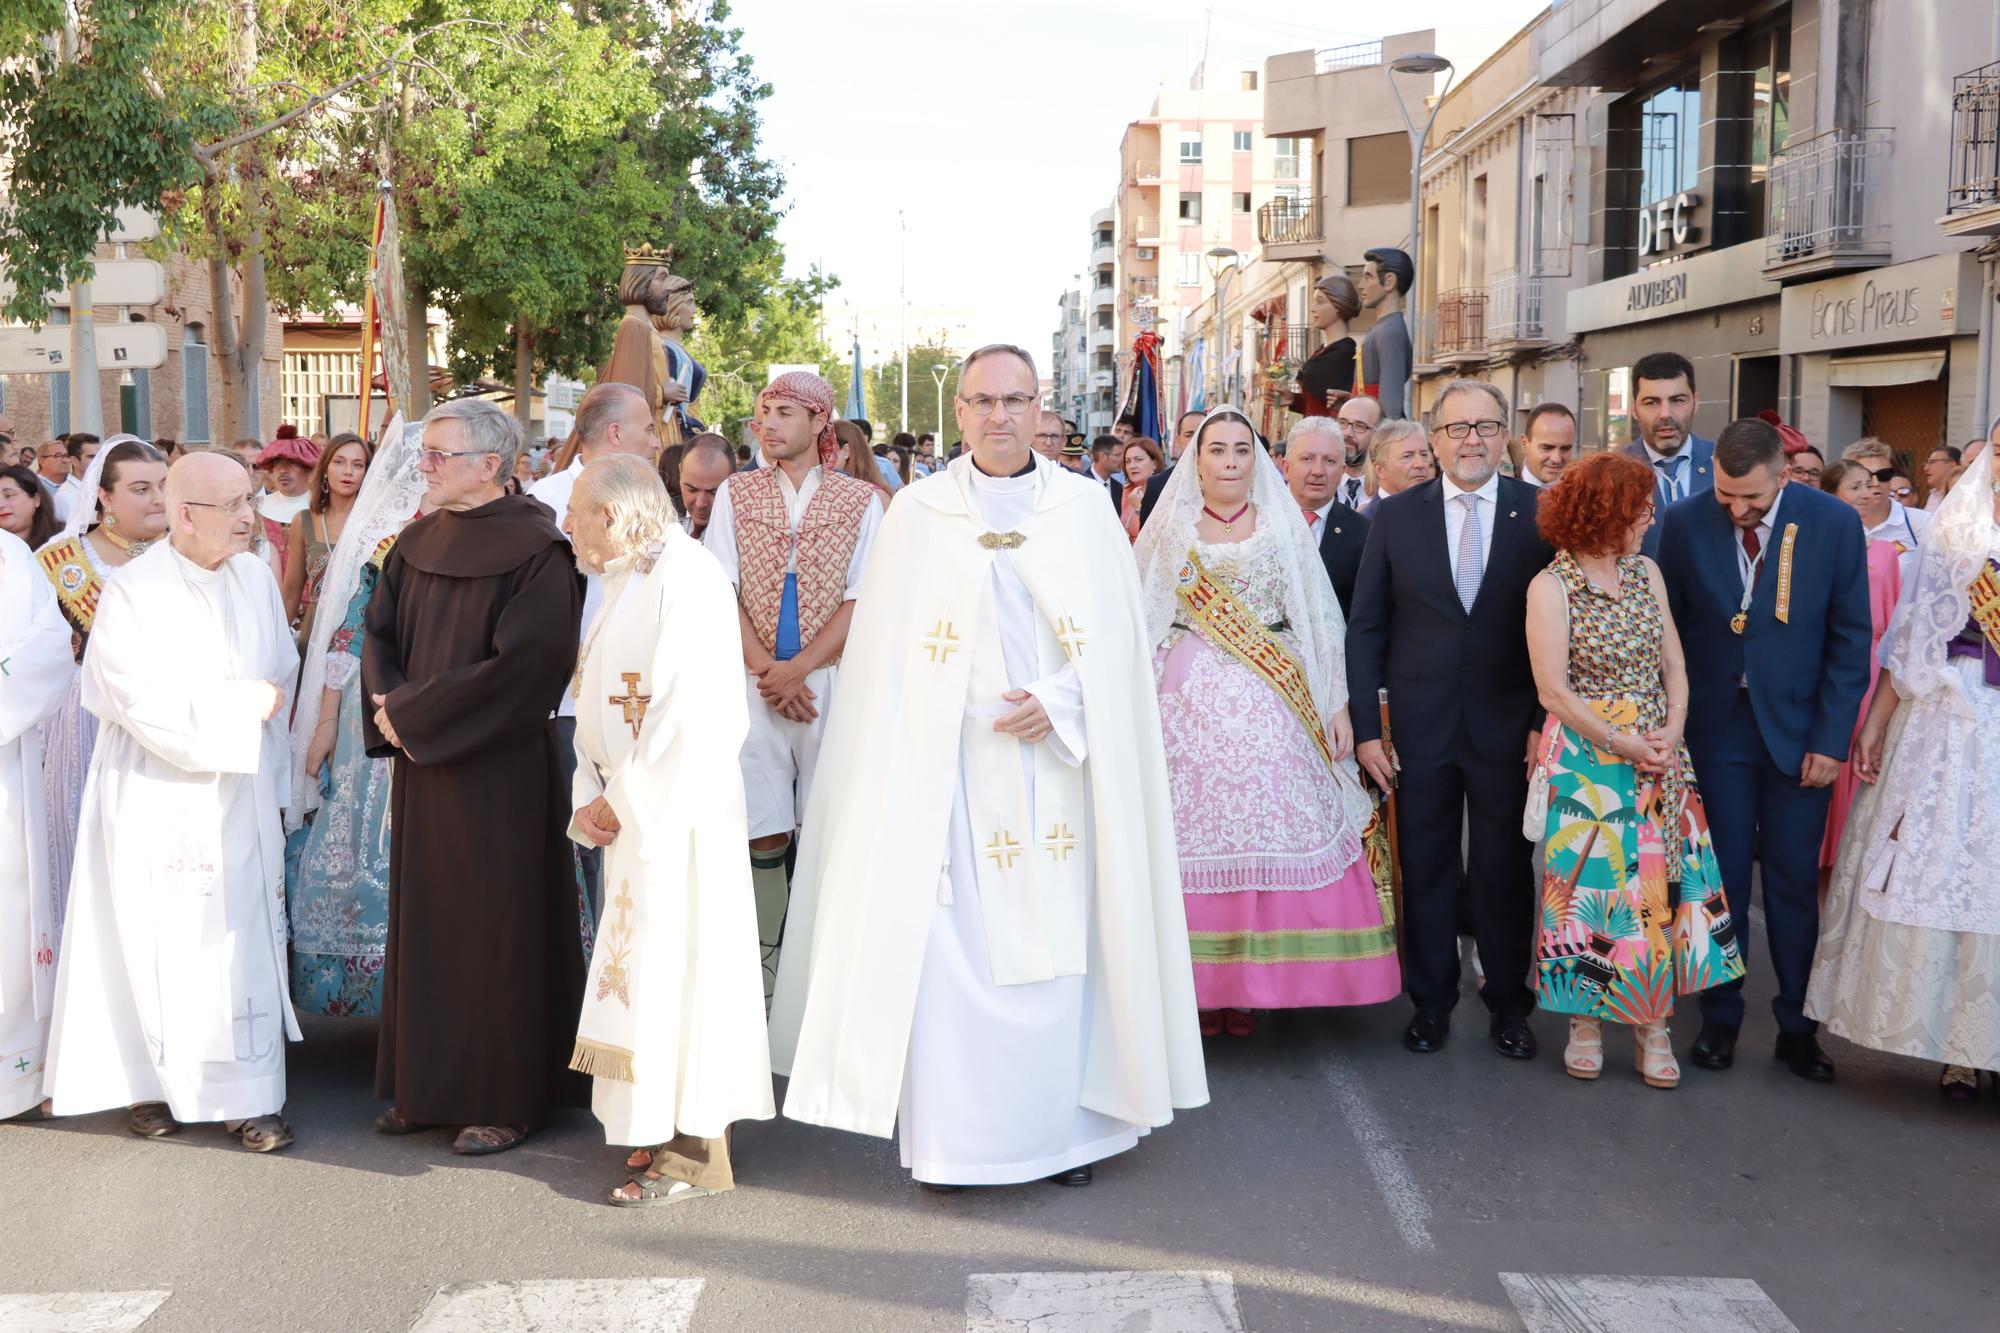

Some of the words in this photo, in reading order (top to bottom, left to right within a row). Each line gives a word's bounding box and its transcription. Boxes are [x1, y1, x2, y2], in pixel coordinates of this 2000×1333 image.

[1639, 193, 1691, 257] DFC
[1627, 273, 1687, 311] ALVIBEN
[1810, 289, 1857, 340] Bons
[1861, 280, 1920, 332] Preus
